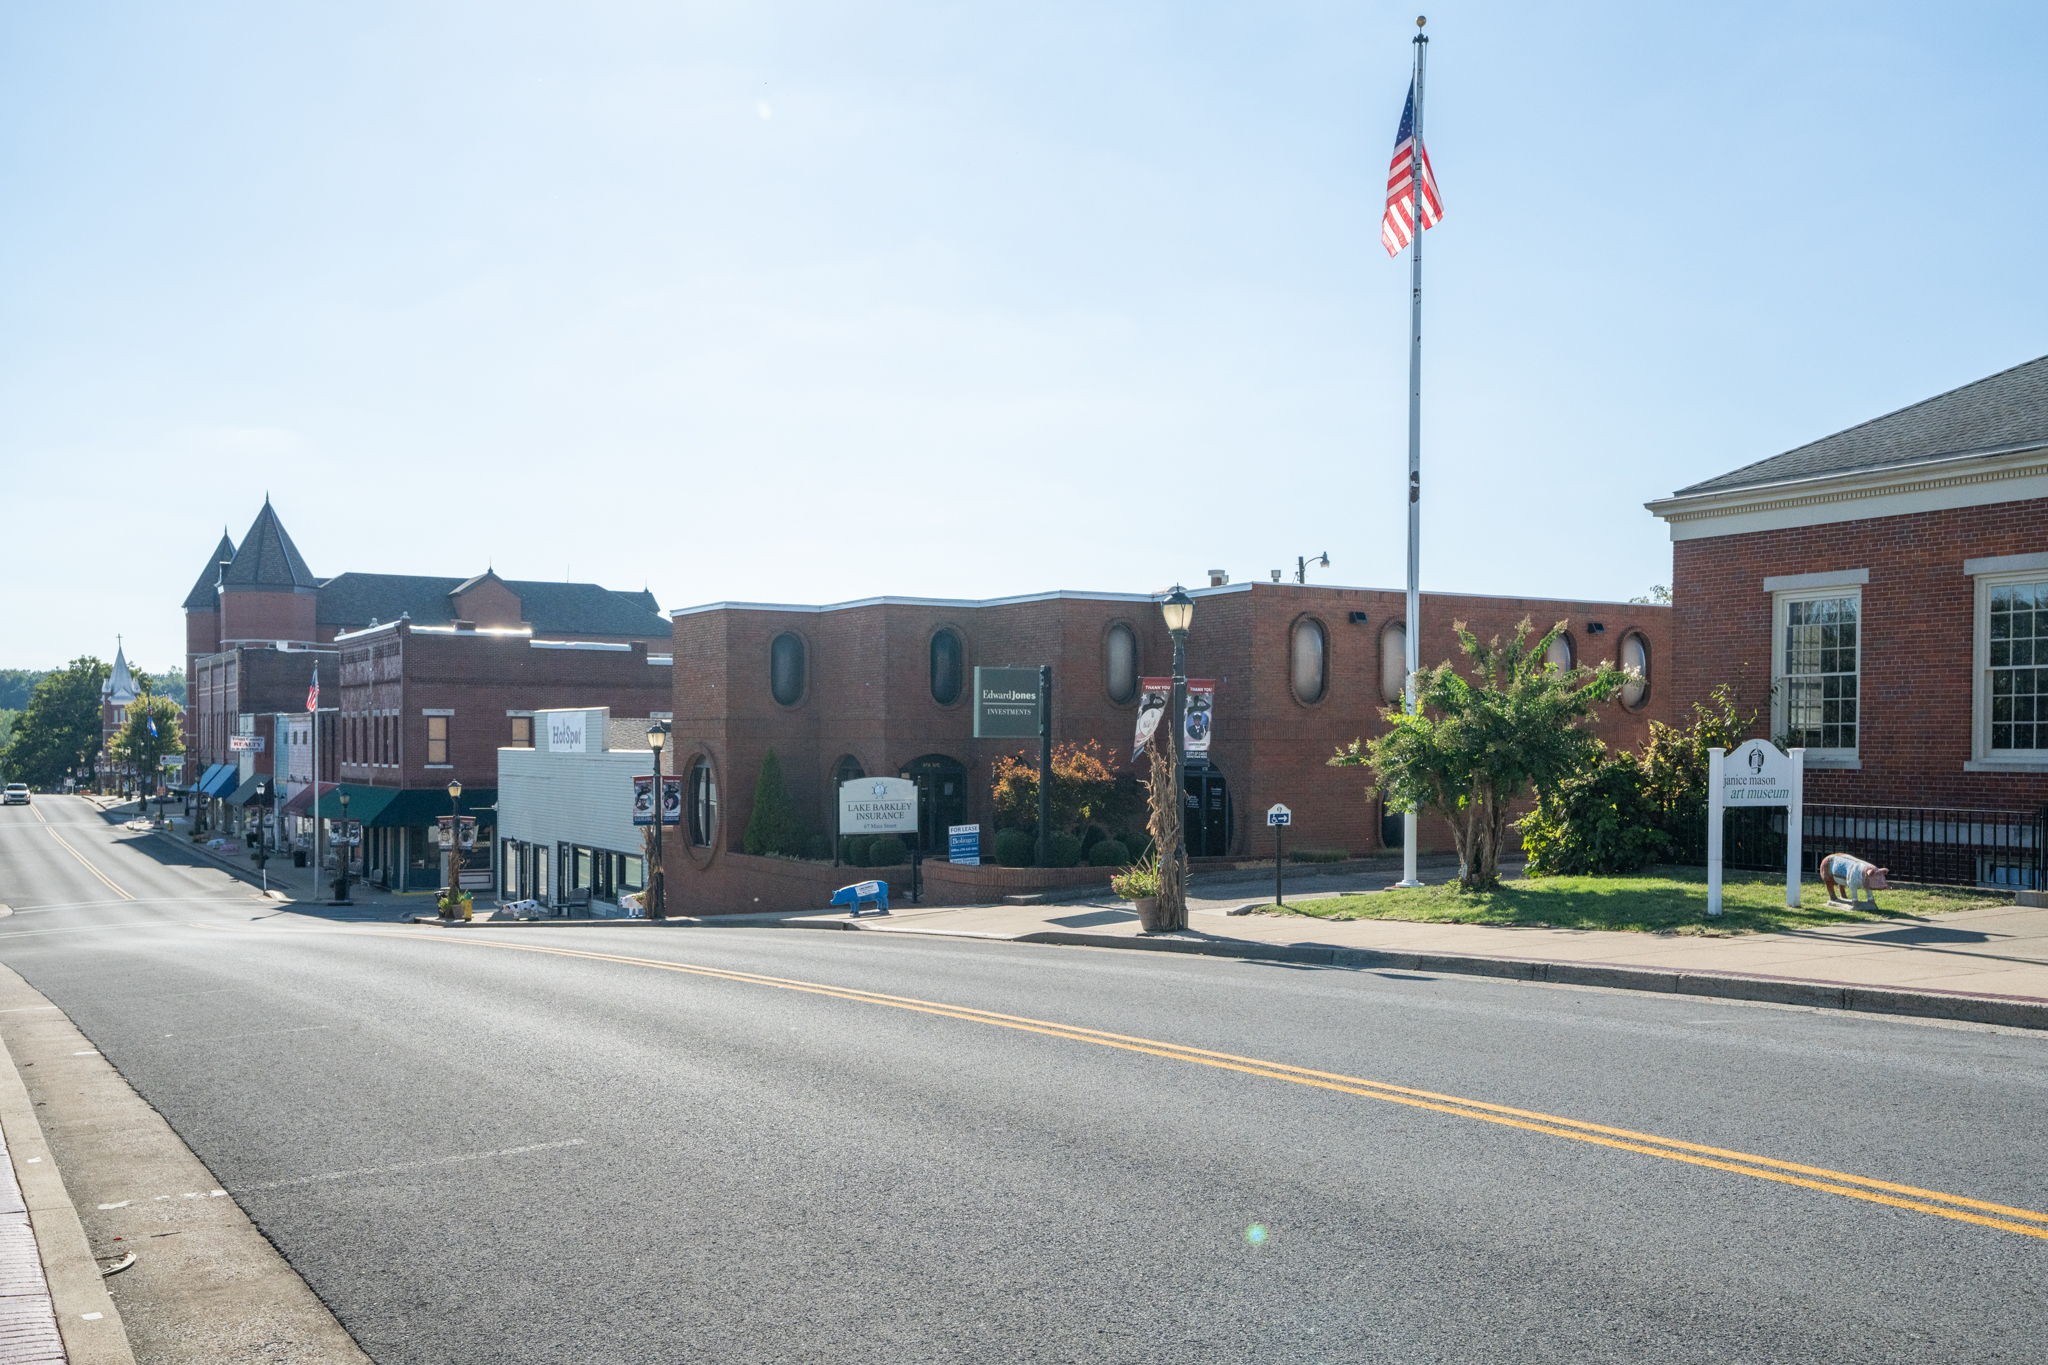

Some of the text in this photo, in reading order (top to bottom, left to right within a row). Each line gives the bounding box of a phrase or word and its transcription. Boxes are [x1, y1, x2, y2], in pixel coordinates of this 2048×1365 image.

[1722, 773, 1776, 789] janice mason
[1730, 788, 1789, 799] art museum
[848, 802, 912, 812] LAKE BARKLEY
[856, 811, 905, 820] INSURANCE
